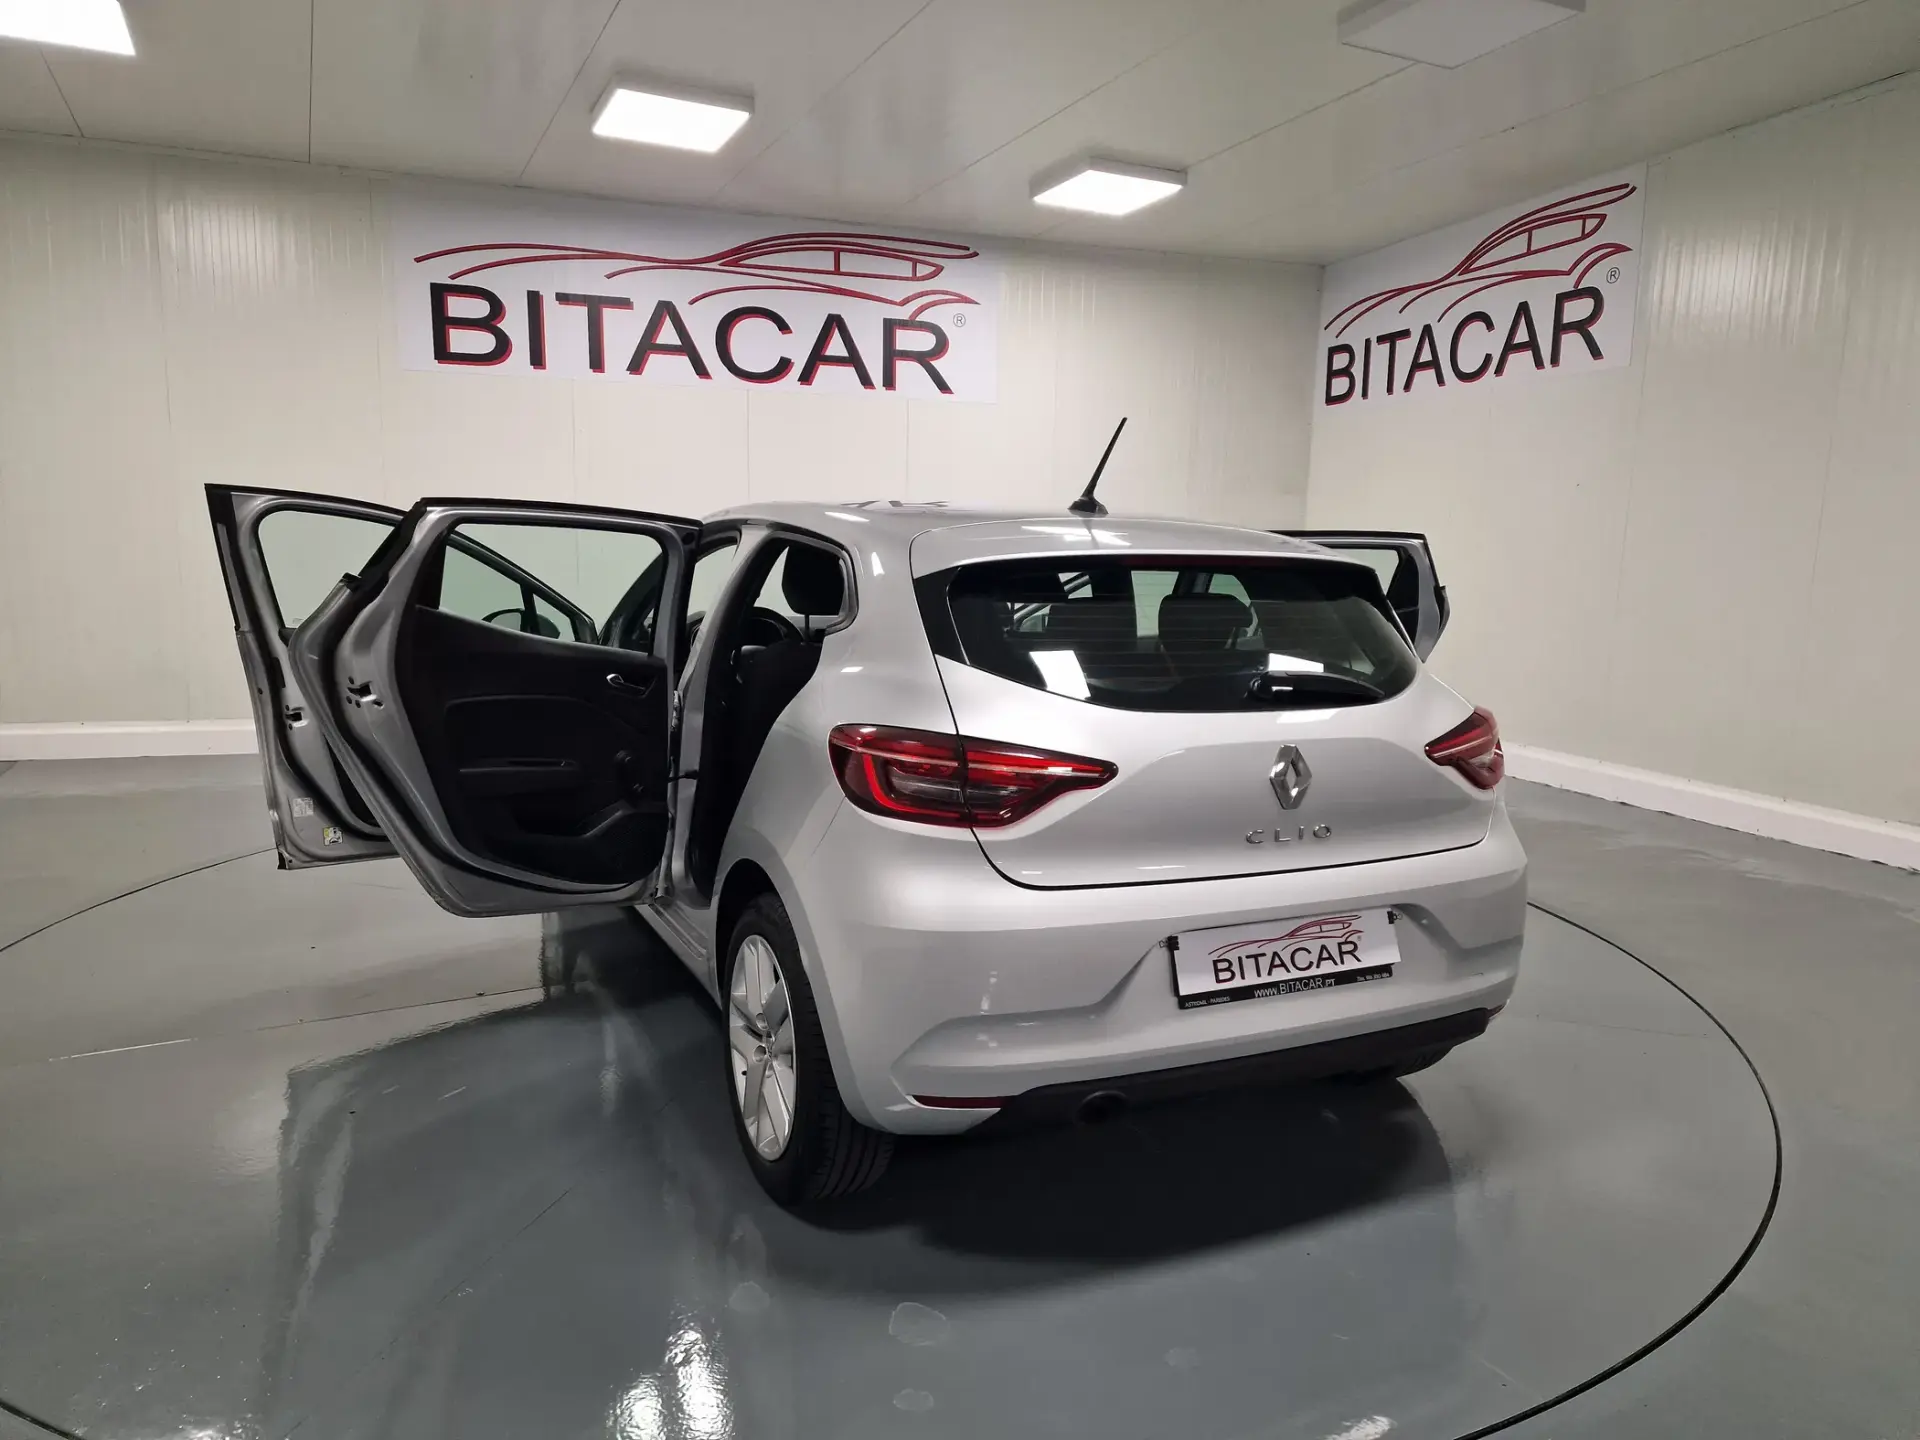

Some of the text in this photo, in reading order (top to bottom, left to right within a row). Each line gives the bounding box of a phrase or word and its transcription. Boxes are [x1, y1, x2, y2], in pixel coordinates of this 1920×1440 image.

[429, 282, 955, 395] BITACAR
[1324, 286, 1605, 406] BITACAR
[1245, 823, 1332, 845] CLIO
[1212, 940, 1362, 984] BITACAR
